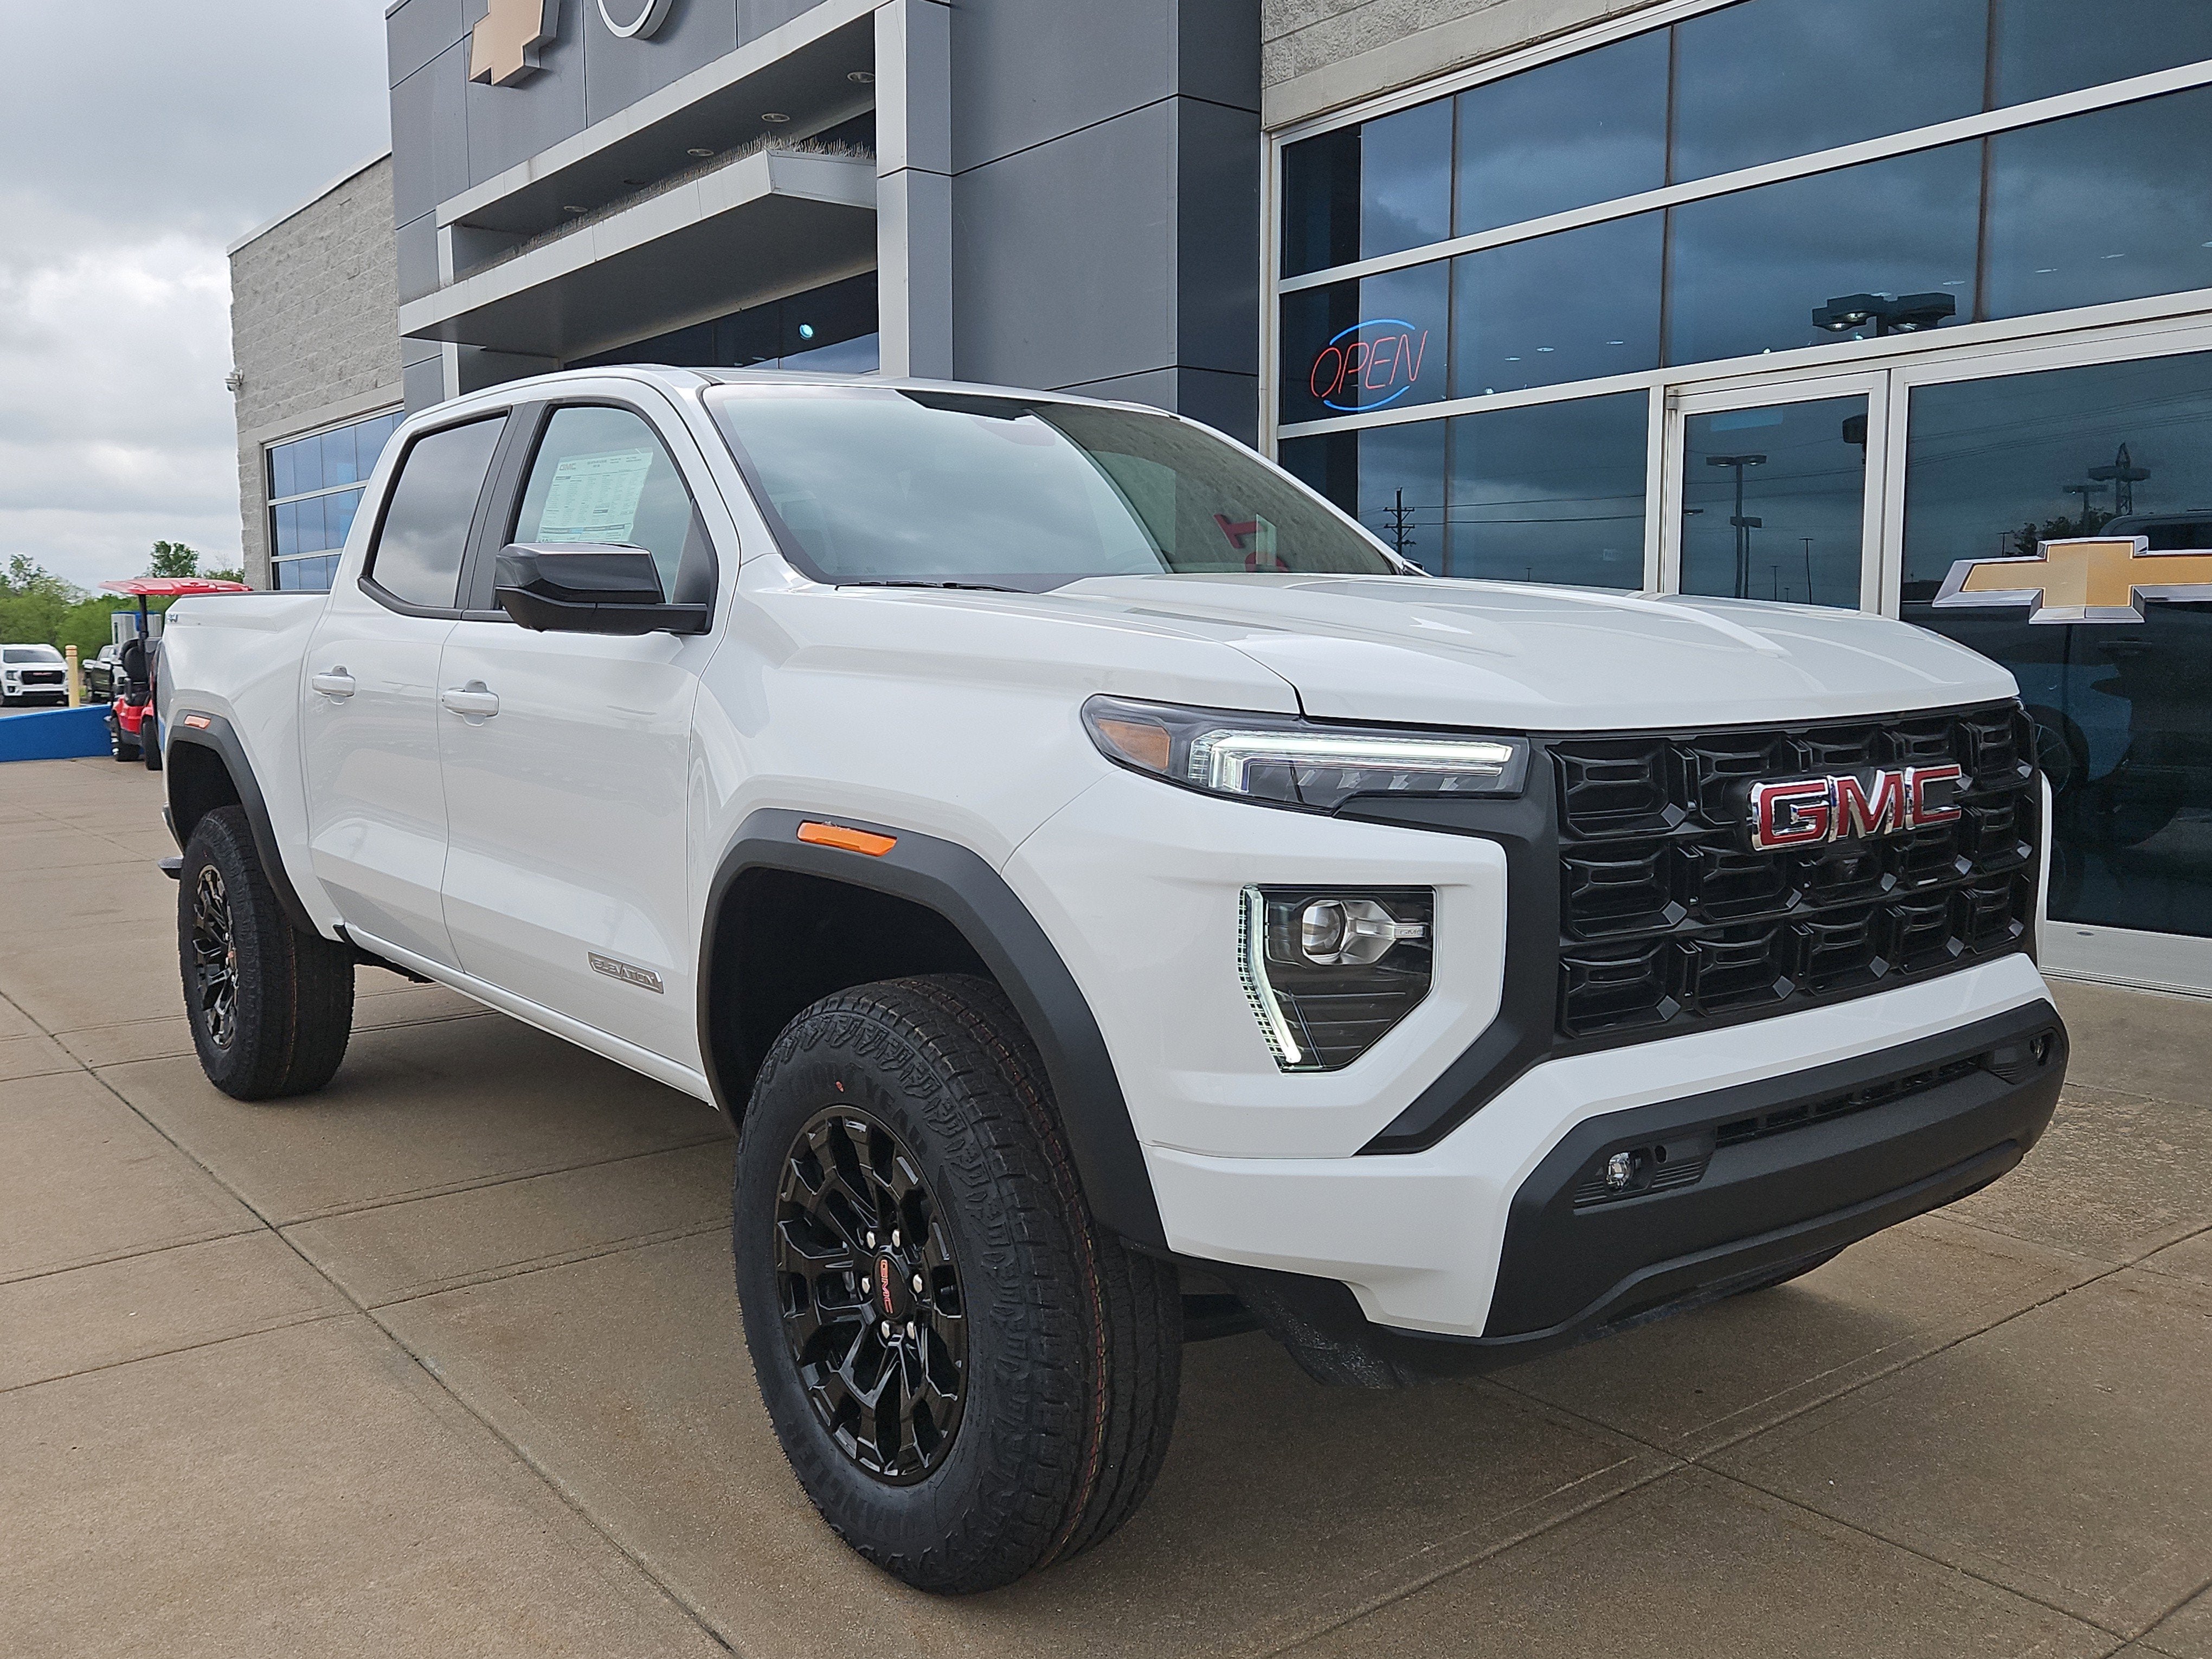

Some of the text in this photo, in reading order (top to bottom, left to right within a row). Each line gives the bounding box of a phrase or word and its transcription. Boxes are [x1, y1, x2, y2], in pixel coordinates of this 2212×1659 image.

[1310, 330, 1428, 397] OPEN
[1752, 764, 1962, 852] GMC
[593, 957, 655, 985] ELEVATION
[880, 1259, 893, 1314] GMC
